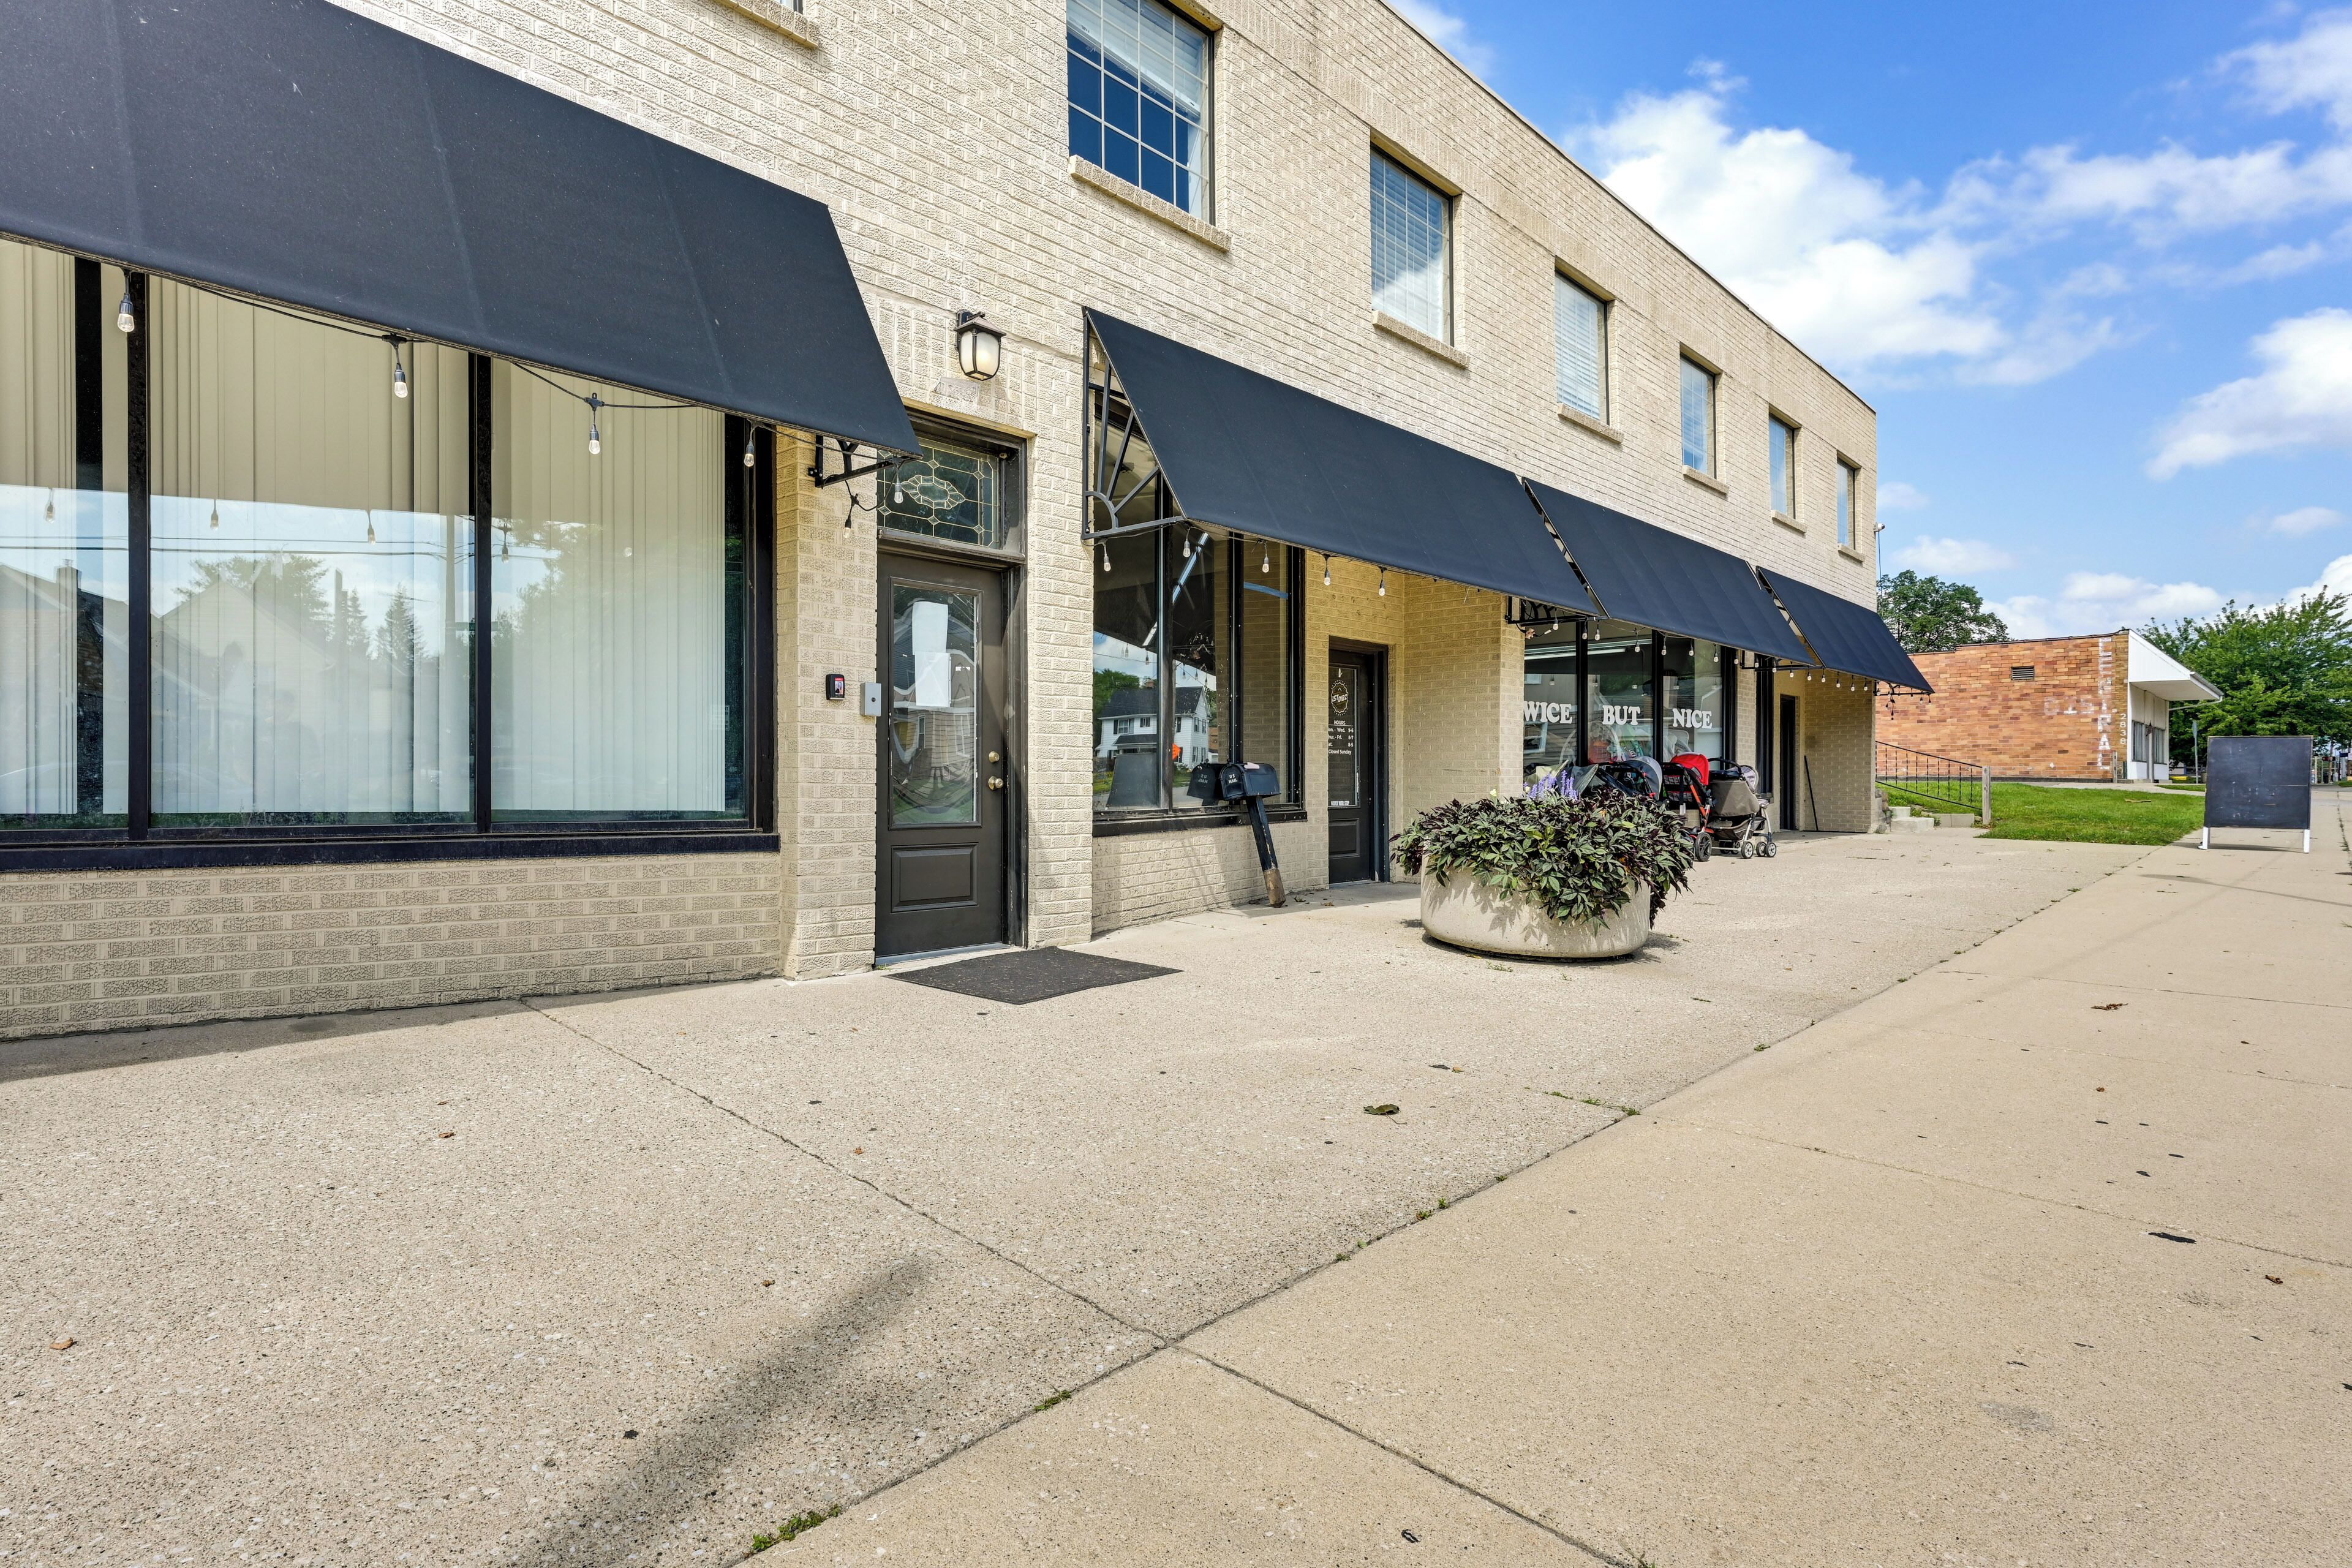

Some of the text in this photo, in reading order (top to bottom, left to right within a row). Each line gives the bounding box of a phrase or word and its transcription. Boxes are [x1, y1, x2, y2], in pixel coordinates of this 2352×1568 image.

[1523, 700, 1713, 729] WICE BUT NICE
[2119, 713, 2128, 745] 2838
